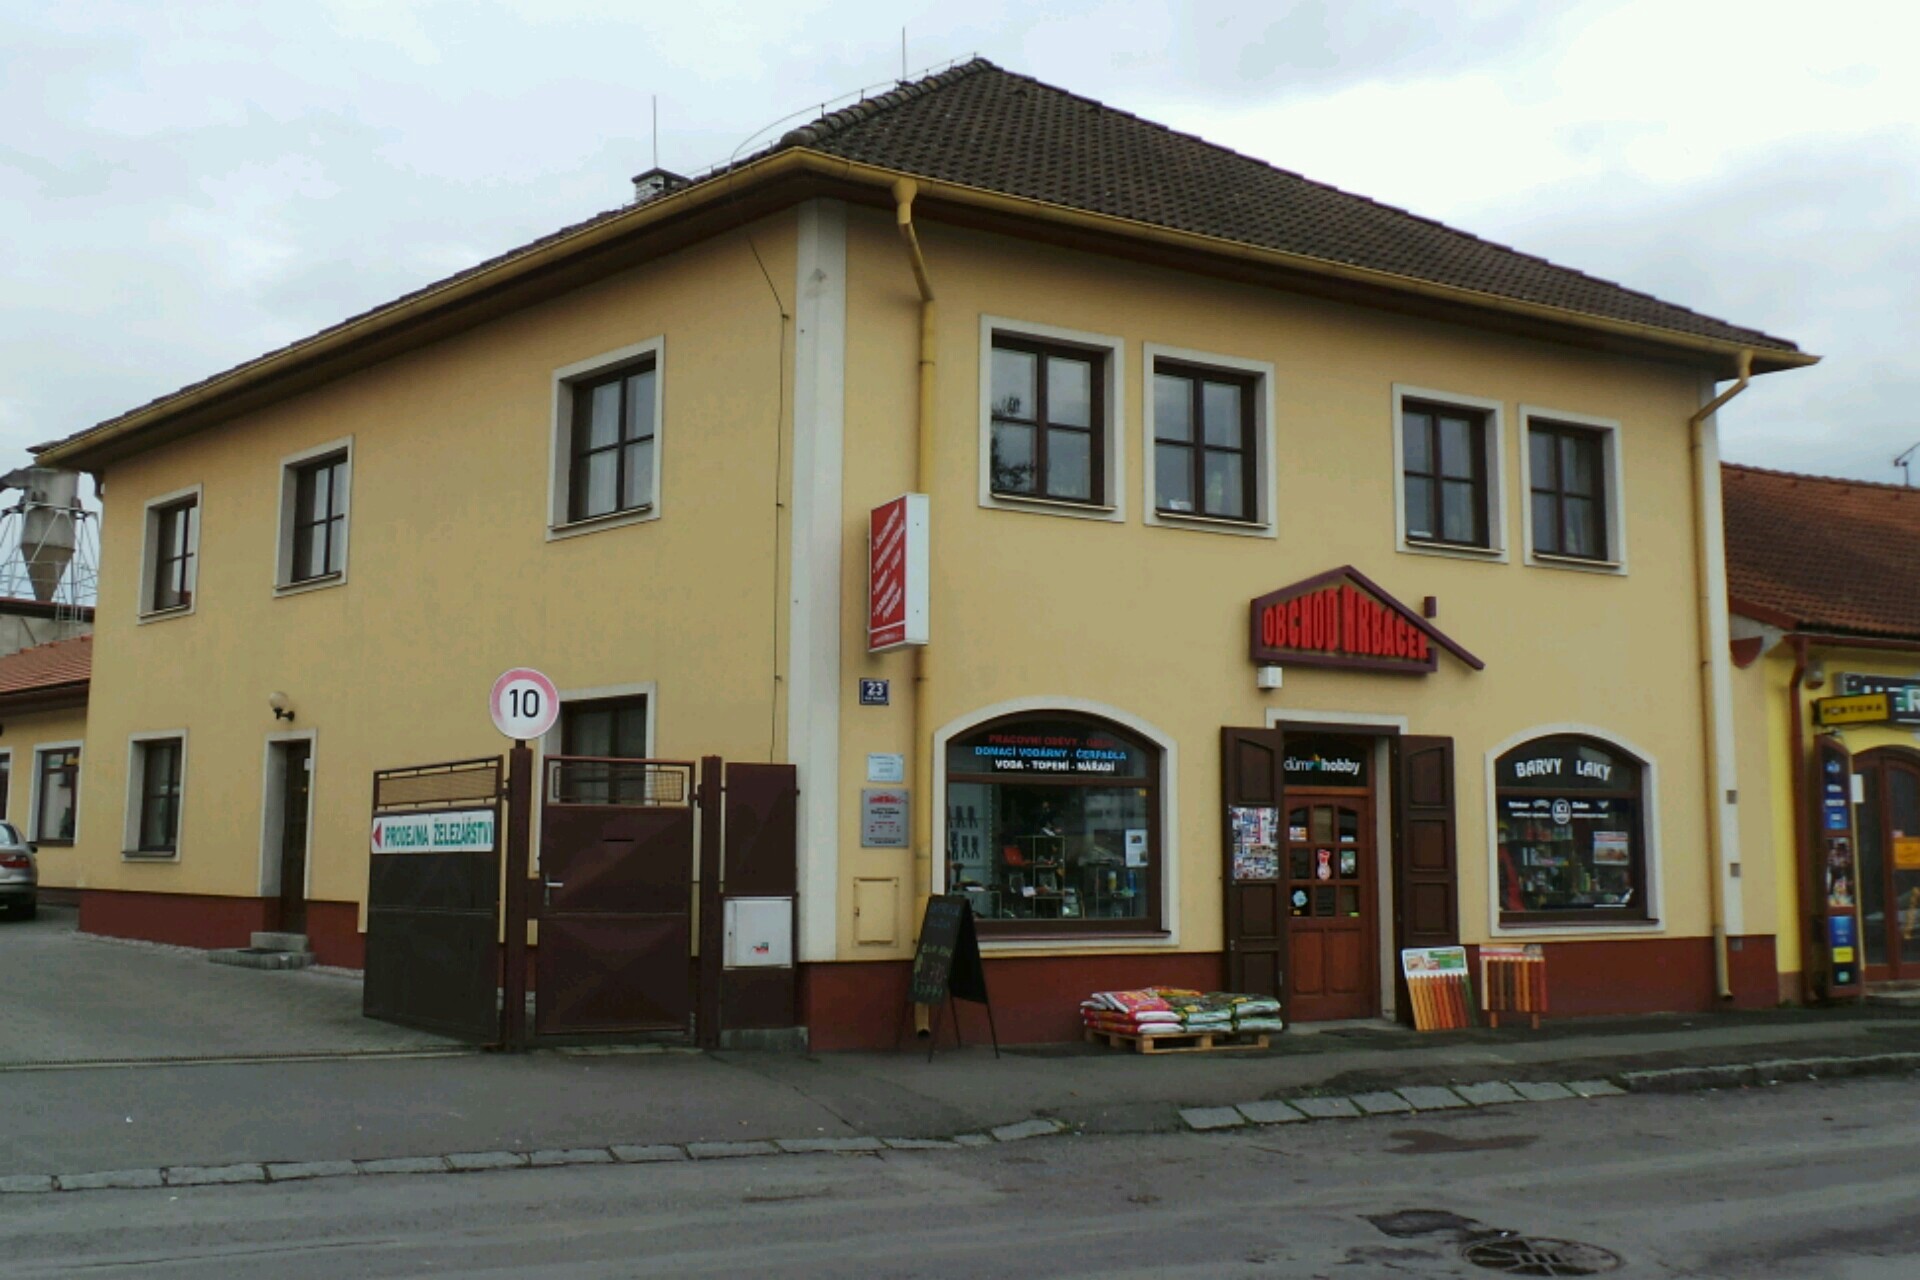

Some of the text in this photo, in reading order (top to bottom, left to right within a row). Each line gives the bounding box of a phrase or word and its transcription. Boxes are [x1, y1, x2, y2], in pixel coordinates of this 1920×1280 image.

[1263, 588, 1338, 651] OBCHOD
[867, 682, 884, 696] 23
[509, 689, 540, 718] 10
[995, 760, 1023, 770] VODA
[1032, 760, 1069, 771] TOPENÍ
[1077, 760, 1115, 772] NÁŘADÍ
[1321, 758, 1360, 775] hobby
[1515, 758, 1612, 781] BARVY LAKY
[385, 825, 430, 848] PRODEJNA
